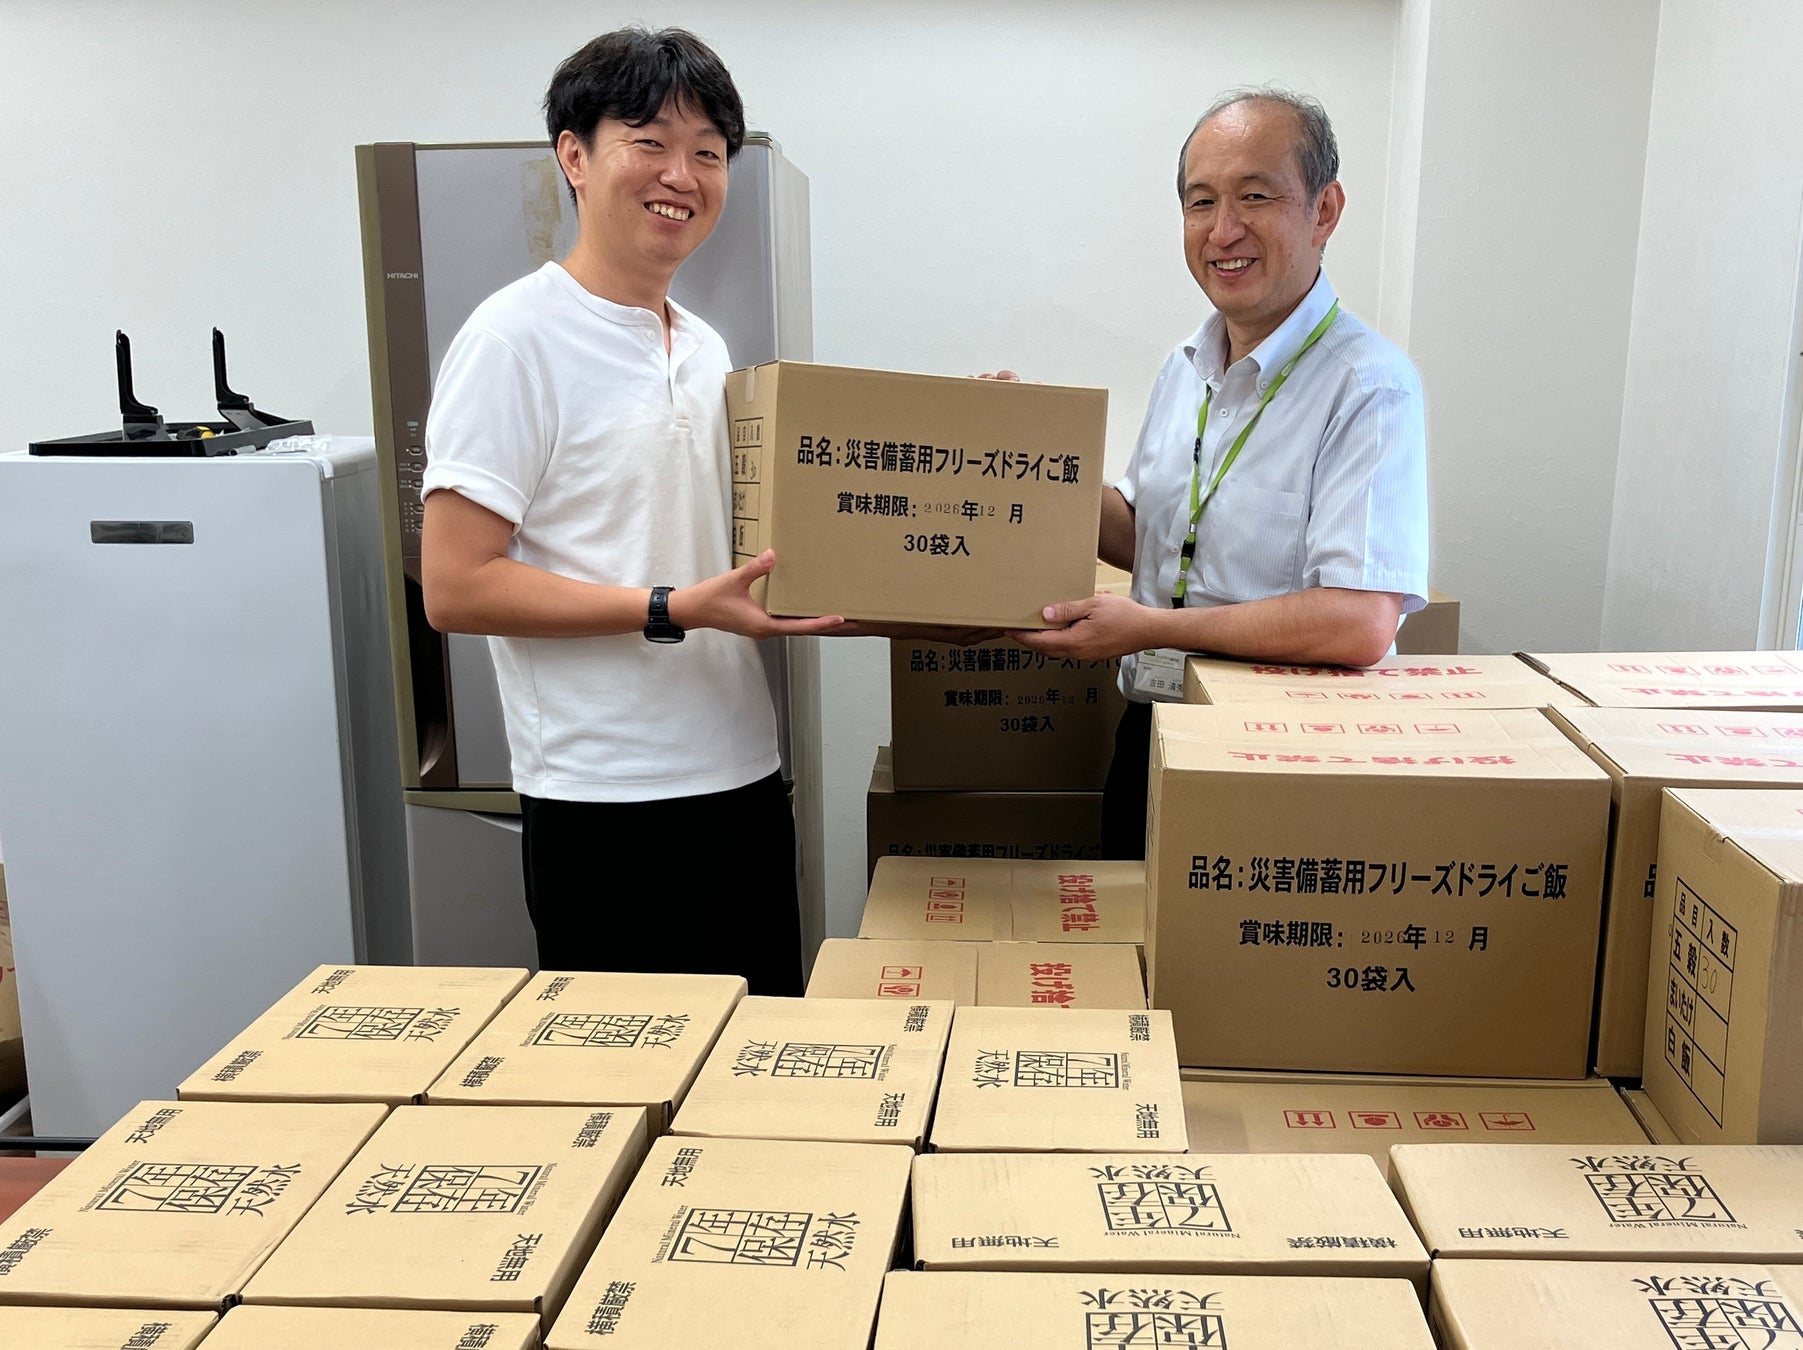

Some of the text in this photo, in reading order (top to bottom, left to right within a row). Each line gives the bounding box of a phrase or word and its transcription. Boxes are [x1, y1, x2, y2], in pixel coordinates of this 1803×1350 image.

[797, 435, 1080, 485] 品名:災害備蓄用フリーズドライご飯
[837, 491, 917, 518] 賞味期限:
[1009, 503, 1024, 524] 月
[904, 533, 971, 556] 30袋入
[999, 715, 1056, 733] 30袋入
[1187, 854, 1569, 900] 品名:災害備蓄用フリーズドライご飯
[1057, 874, 1100, 932] 投げ捨て禁止
[1678, 892, 1698, 928] 品目
[1239, 919, 1344, 948] 賞味期限:
[1468, 926, 1489, 951] 月
[1672, 928, 1698, 978] 五穀
[1706, 919, 1729, 958] 入数
[1030, 962, 1076, 1008] 投げ捨
[1326, 966, 1416, 992] 30袋入
[1701, 955, 1717, 994] 30
[1669, 977, 1694, 1026] まいたけ
[347, 1007, 416, 1040] 保存
[403, 1007, 461, 1043] 天然水
[588, 1015, 645, 1047] 保存
[641, 1013, 690, 1049] 天然水
[731, 1039, 778, 1077] 天然水
[777, 1043, 829, 1077] 保存
[972, 1048, 1010, 1089] 天然水
[1018, 1052, 1065, 1086] 保存
[1667, 1025, 1691, 1077] 白飯
[124, 1108, 183, 1144] 天地無用
[661, 1147, 703, 1187] 天地無用
[1087, 1164, 1217, 1181] 天然水
[1569, 1155, 1702, 1172] 天然水
[165, 1165, 245, 1212] 保存
[226, 1163, 302, 1218] 天然水
[345, 1163, 416, 1215] 天然水
[400, 1166, 477, 1212] 保存
[1104, 1182, 1215, 1207] 保存
[1594, 1174, 1706, 1198] 保存
[736, 1212, 808, 1263] 保存
[806, 1211, 861, 1271] 天然水
[952, 1236, 1060, 1249] 天地無用
[1195, 1231, 1240, 1239] Natural
[1458, 1227, 1570, 1239] 天地無用
[490, 1233, 543, 1282] 天地無用
[1077, 1288, 1225, 1310] 天然水
[1631, 1275, 1783, 1298] 天然水
[584, 1281, 637, 1335] 横積厳禁
[1660, 1299, 1787, 1330] 保存
[120, 1323, 172, 1350] 横積
[455, 1324, 499, 1350] 横積
[1091, 1313, 1219, 1345] 保存
